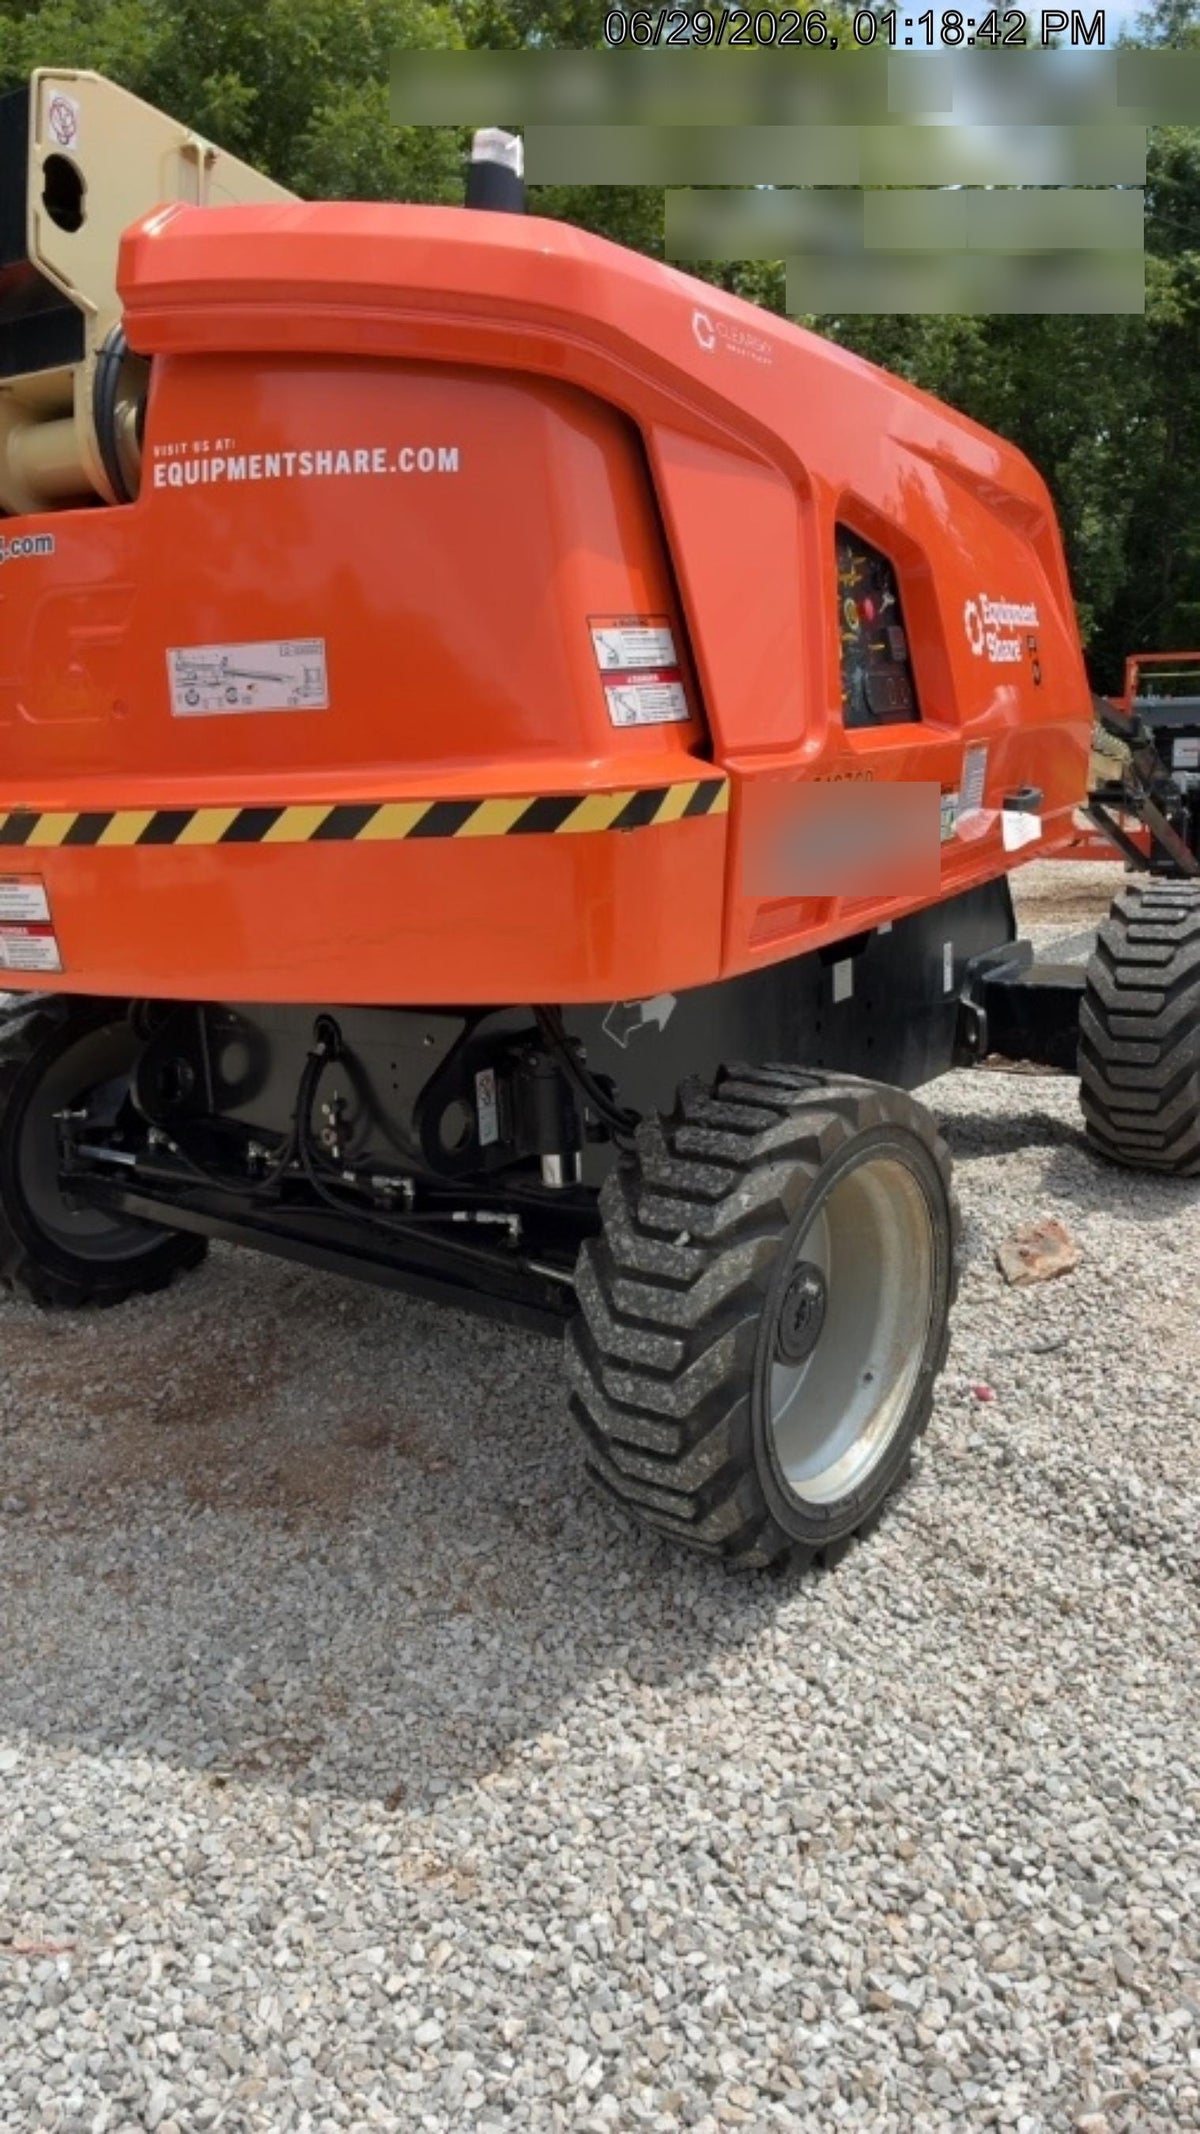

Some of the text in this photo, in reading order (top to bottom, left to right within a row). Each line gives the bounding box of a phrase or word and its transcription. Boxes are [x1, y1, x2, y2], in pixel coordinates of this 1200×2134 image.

[153, 443, 188, 458] VISIT
[193, 440, 210, 454] US
[153, 447, 460, 488] EQUIPMENTSHARE.COM
